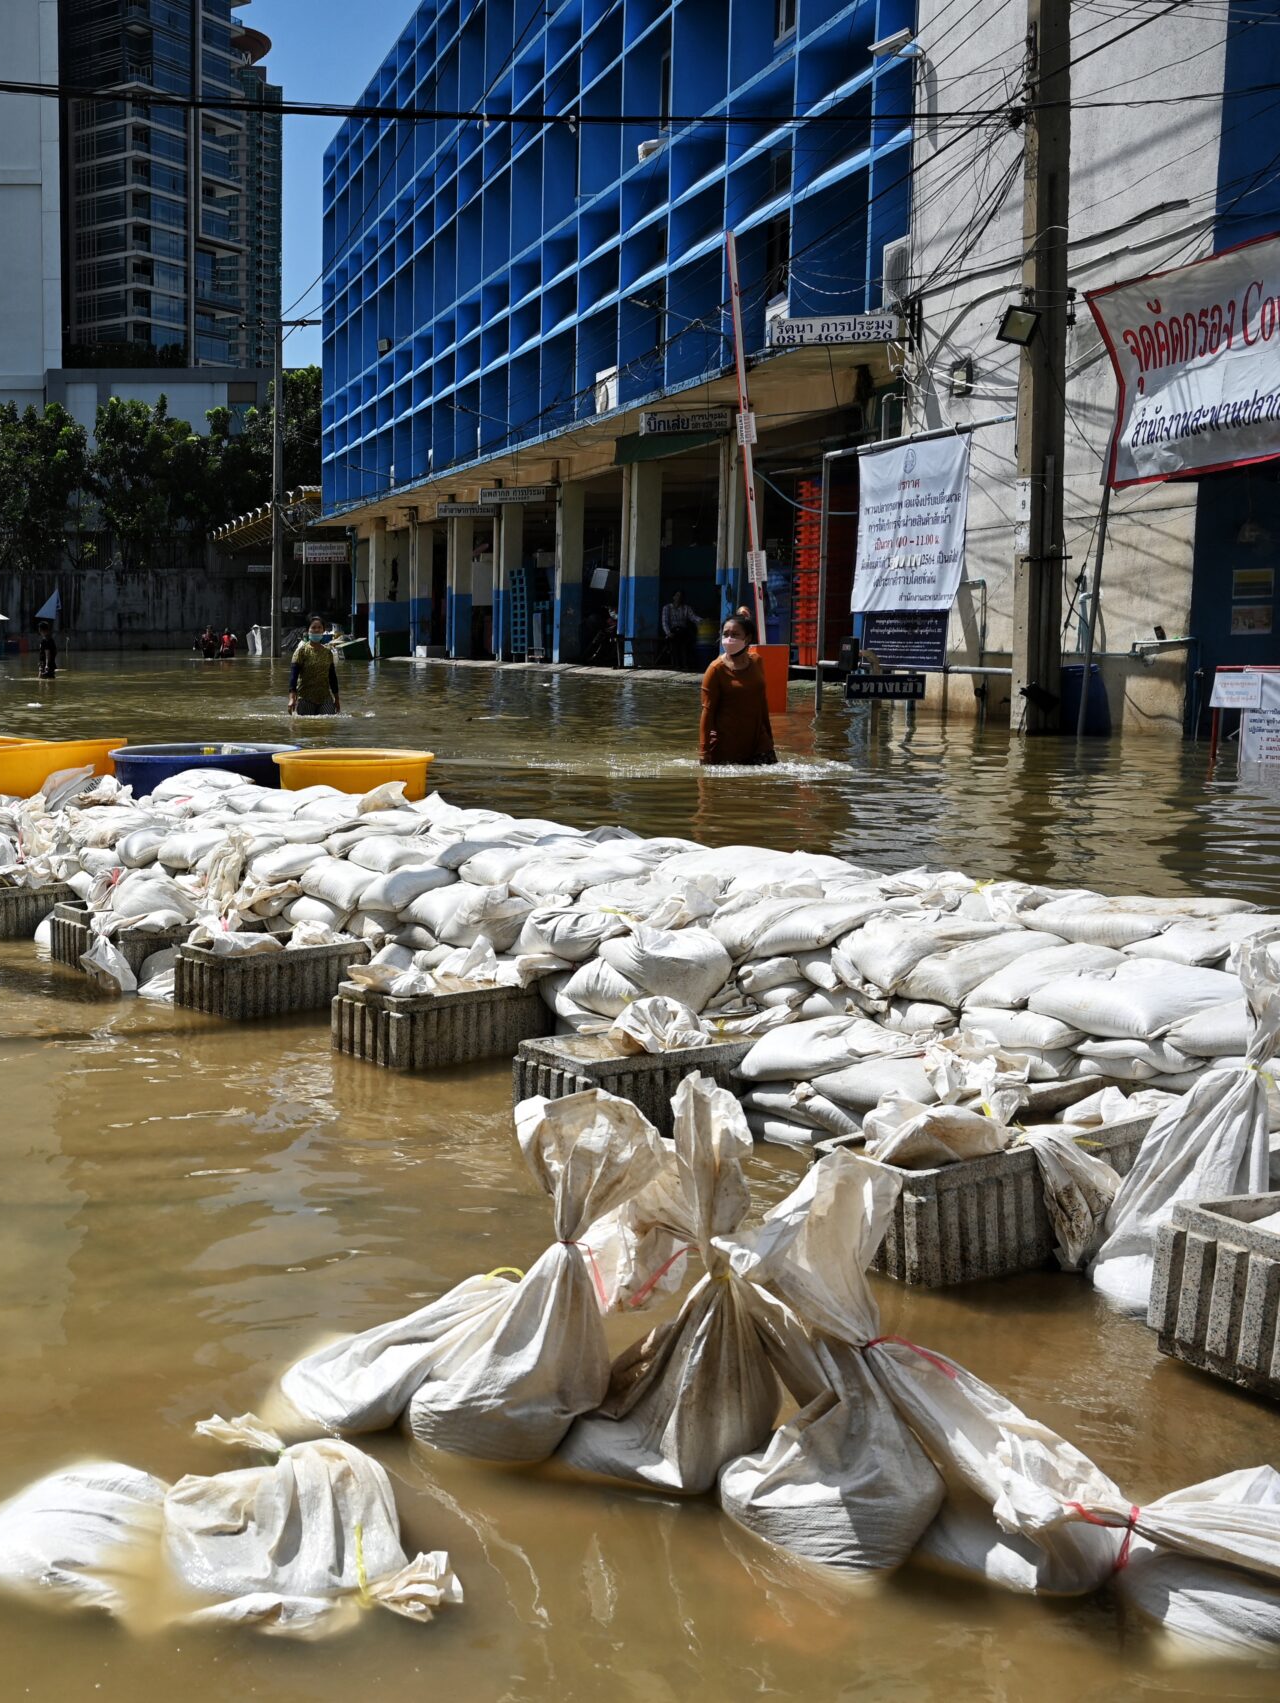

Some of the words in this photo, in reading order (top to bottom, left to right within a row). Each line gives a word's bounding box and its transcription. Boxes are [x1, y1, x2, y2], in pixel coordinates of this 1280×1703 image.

[776, 320, 813, 335] รัตนา
[821, 318, 893, 333] การประมง
[776, 330, 893, 344] 081-466-0926
[1123, 299, 1236, 395] จุดคัดกรอง
[1242, 279, 1280, 347] Co
[916, 534, 934, 546] 11.00
[861, 677, 923, 693] ทางเข้า
